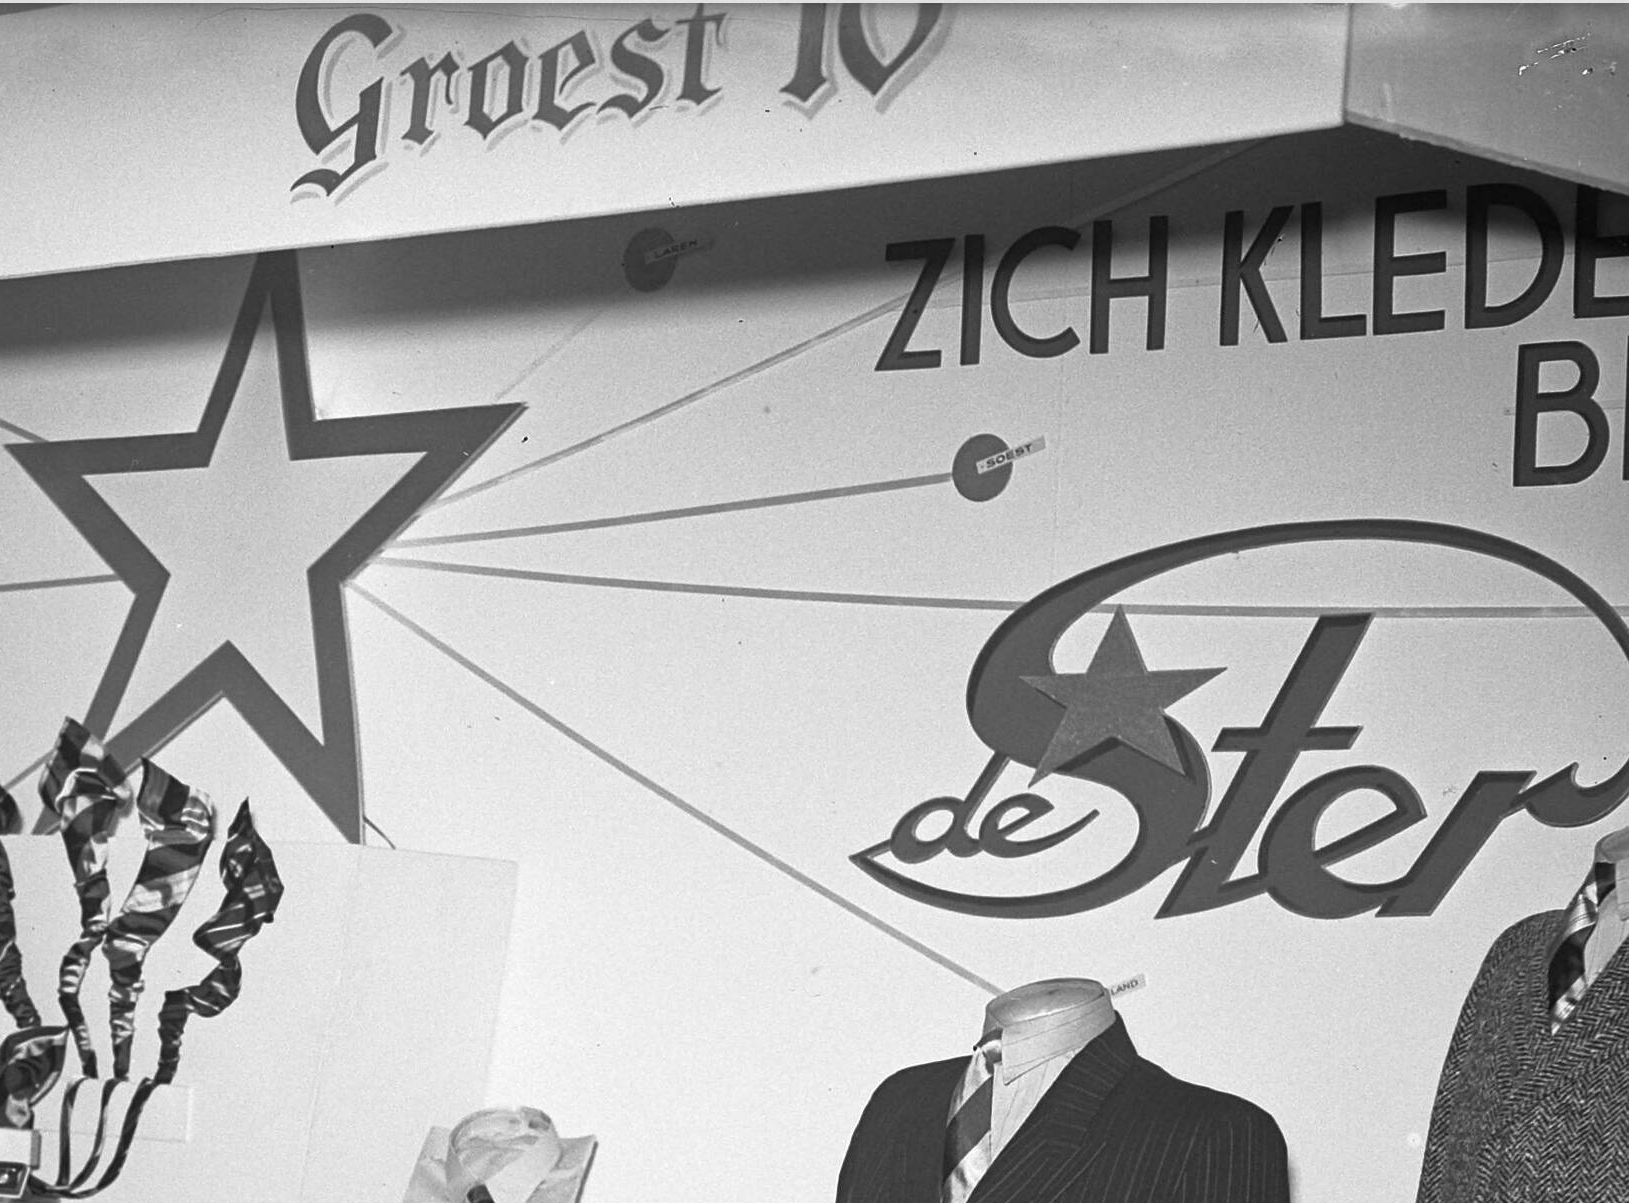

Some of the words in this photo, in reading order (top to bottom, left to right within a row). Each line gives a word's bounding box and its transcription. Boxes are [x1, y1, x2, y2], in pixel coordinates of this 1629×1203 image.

[290, 3, 729, 200] Groest
[874, 215, 1169, 371] ZICH
[986, 443, 1033, 469] SOEST
[849, 518, 1629, 921] Ster
[889, 752, 1100, 864] de
